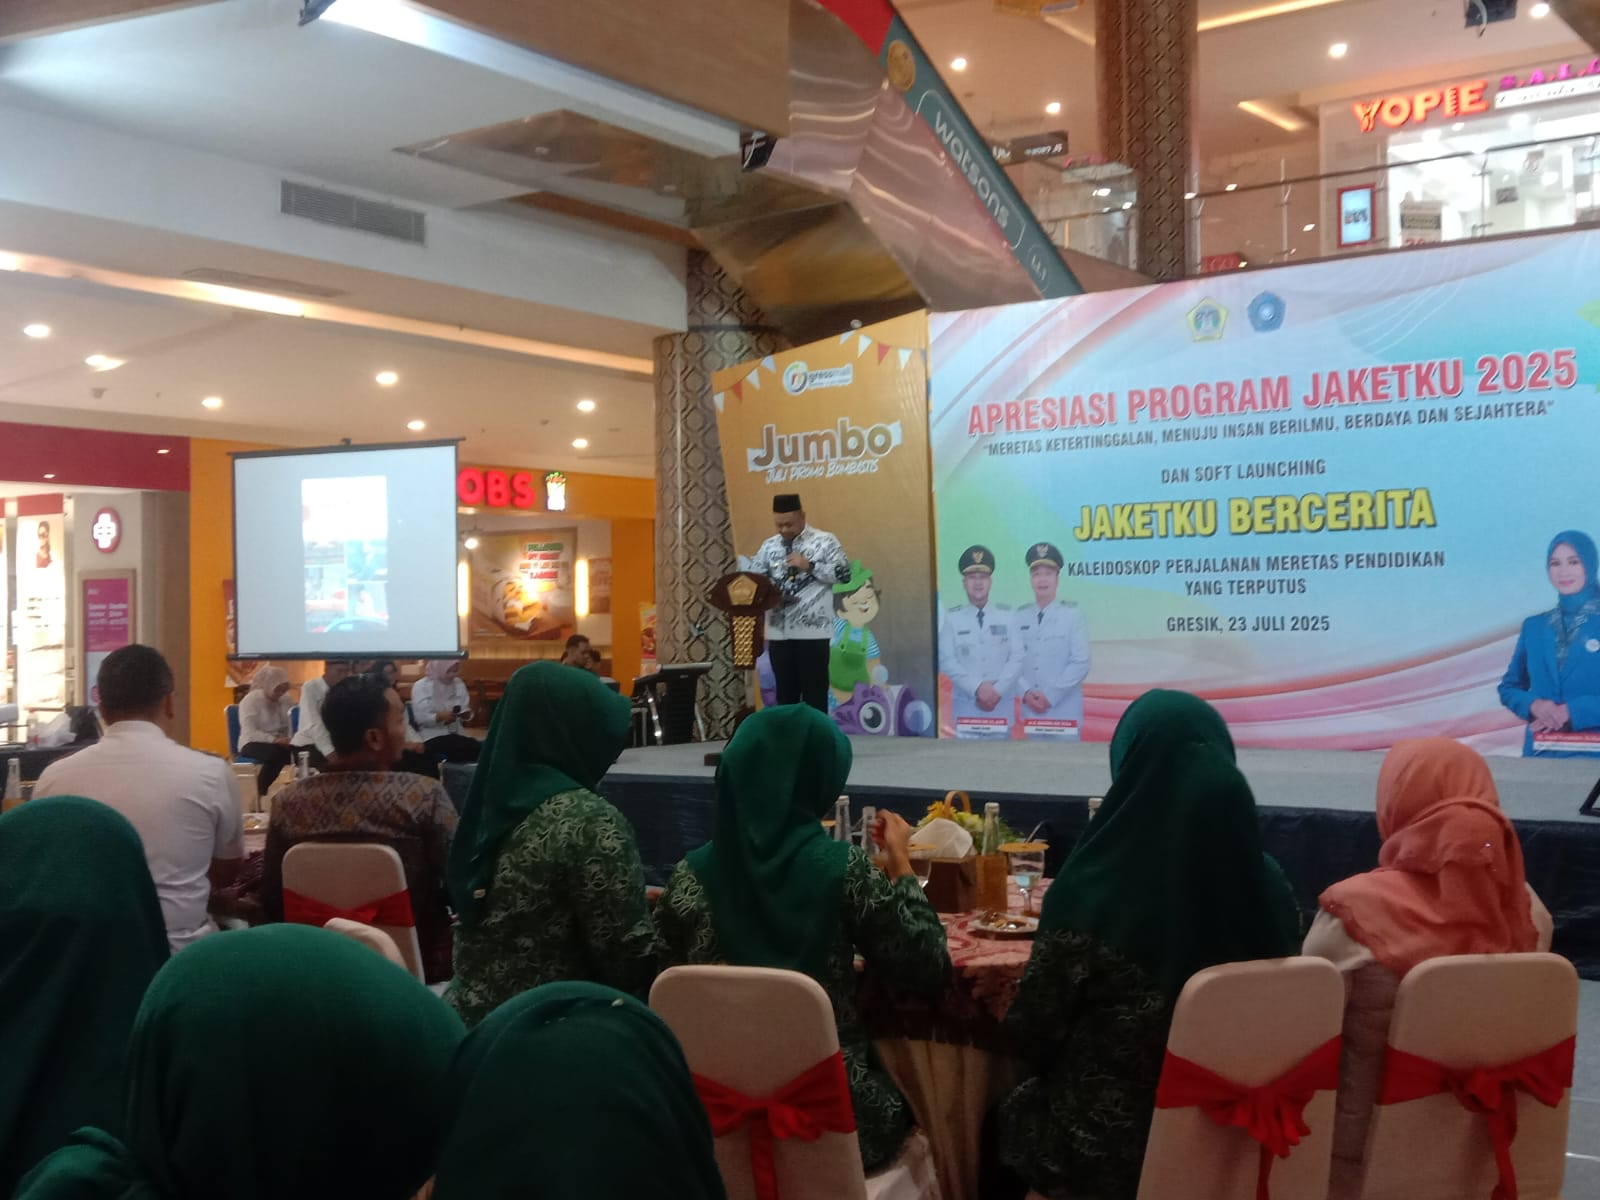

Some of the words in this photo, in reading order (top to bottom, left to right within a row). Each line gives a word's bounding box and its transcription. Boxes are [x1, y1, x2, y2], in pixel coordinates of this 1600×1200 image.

[1352, 79, 1490, 133] YOPIE
[935, 109, 1010, 230] watsons
[968, 391, 1117, 436] APRESIASI
[1128, 376, 1290, 423] PROGRAM
[1302, 358, 1463, 409] JAKETKU
[1476, 349, 1578, 394] 2025
[752, 417, 894, 468] Jumbo
[1046, 432, 1157, 452] KETERTINGGALAN,
[1162, 426, 1218, 443] MENUJU
[1223, 423, 1265, 439] INSAN
[1269, 416, 1339, 434] BERILMU,
[1344, 409, 1412, 430] BERDAYA
[1417, 406, 1450, 424] DAN
[1161, 468, 1190, 484] DAN
[1194, 464, 1232, 482] SOFT
[1237, 459, 1327, 480] LAUNCHING
[1073, 498, 1218, 543] JAKETKU
[1228, 487, 1437, 536] BERCERITA
[1067, 559, 1161, 577] KALEIDOSKOP
[1165, 557, 1262, 575] PERJALANAN
[1266, 553, 1340, 573] MERETAS
[1344, 550, 1446, 570] PENDIDIKAN
[1184, 579, 1223, 597] YANG
[1227, 577, 1307, 596] TERPUTUS
[1166, 616, 1224, 634] GRESIK,
[1228, 615, 1247, 632] 23
[1251, 615, 1286, 632] JULI
[1290, 614, 1331, 631] 2025
